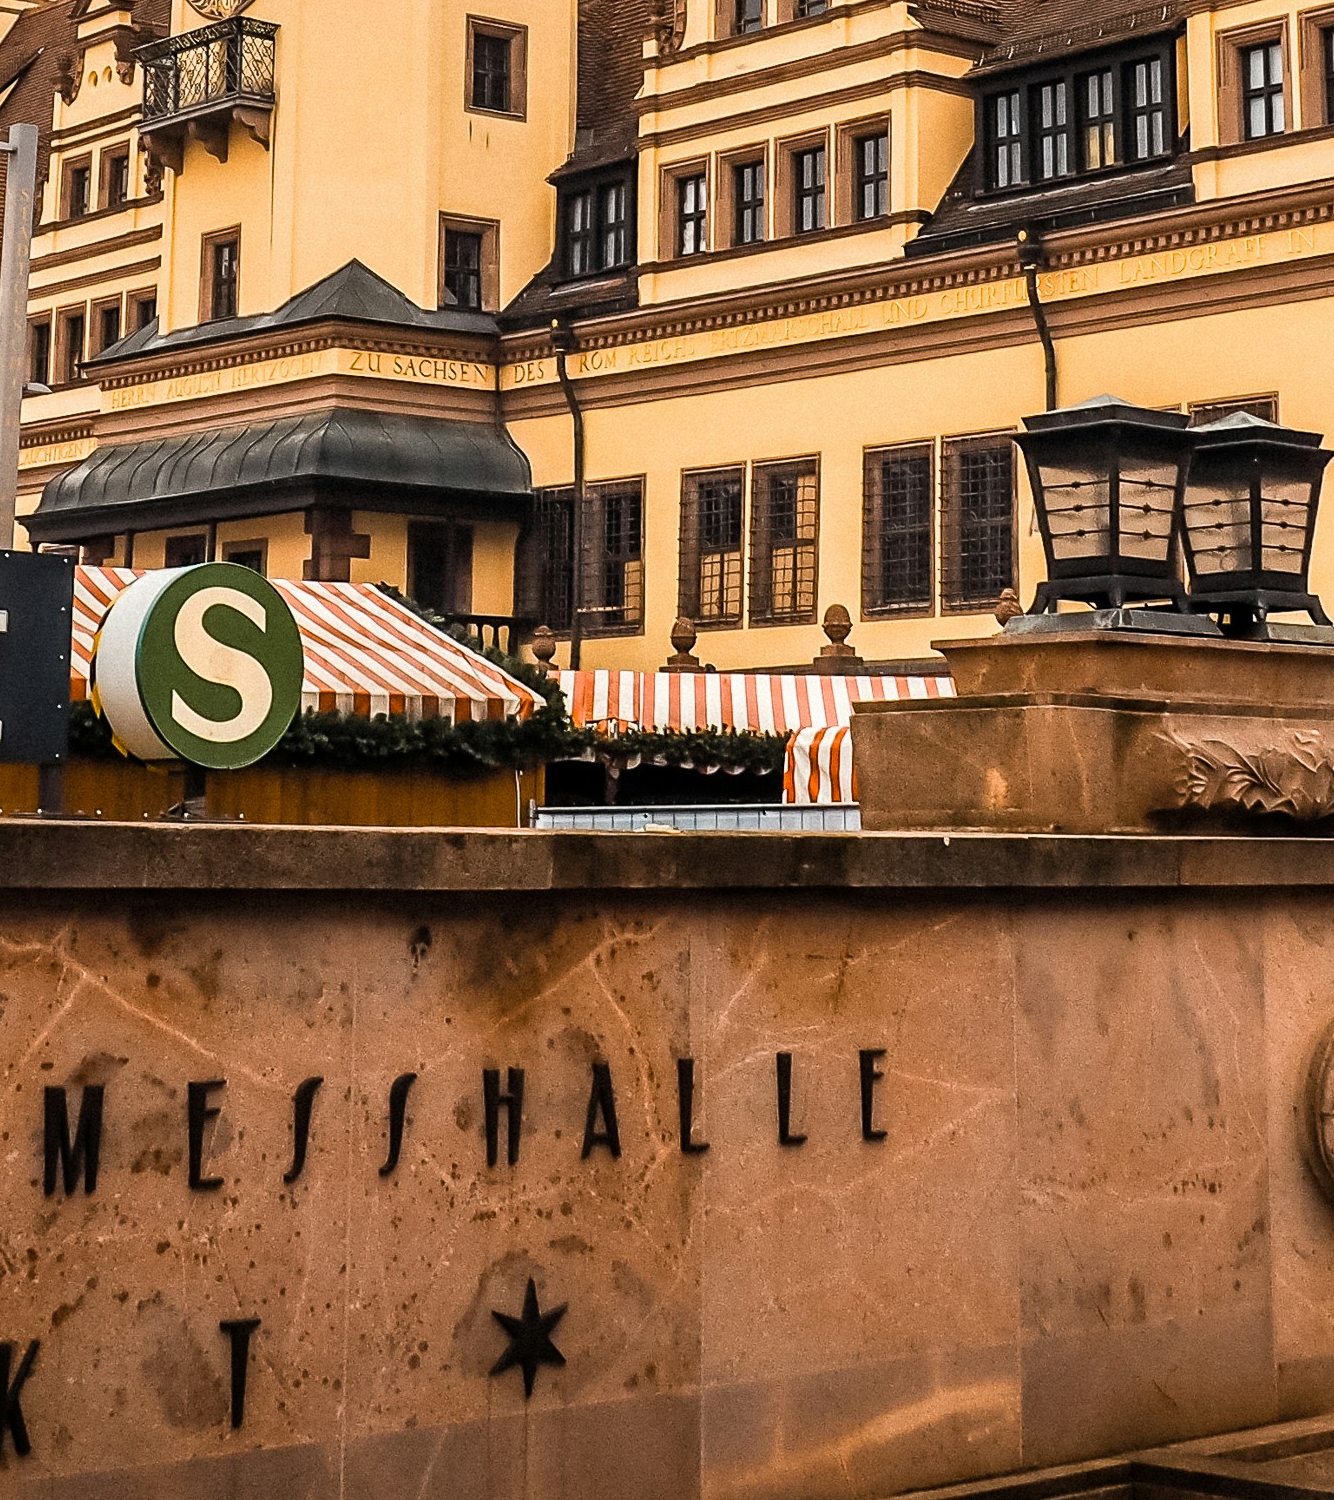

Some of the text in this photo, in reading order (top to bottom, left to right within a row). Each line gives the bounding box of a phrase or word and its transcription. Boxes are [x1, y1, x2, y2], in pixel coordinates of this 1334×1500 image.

[349, 350, 381, 372] ZU
[393, 356, 489, 382] SACHSEN
[513, 360, 545, 384] DES
[171, 586, 274, 746] S
